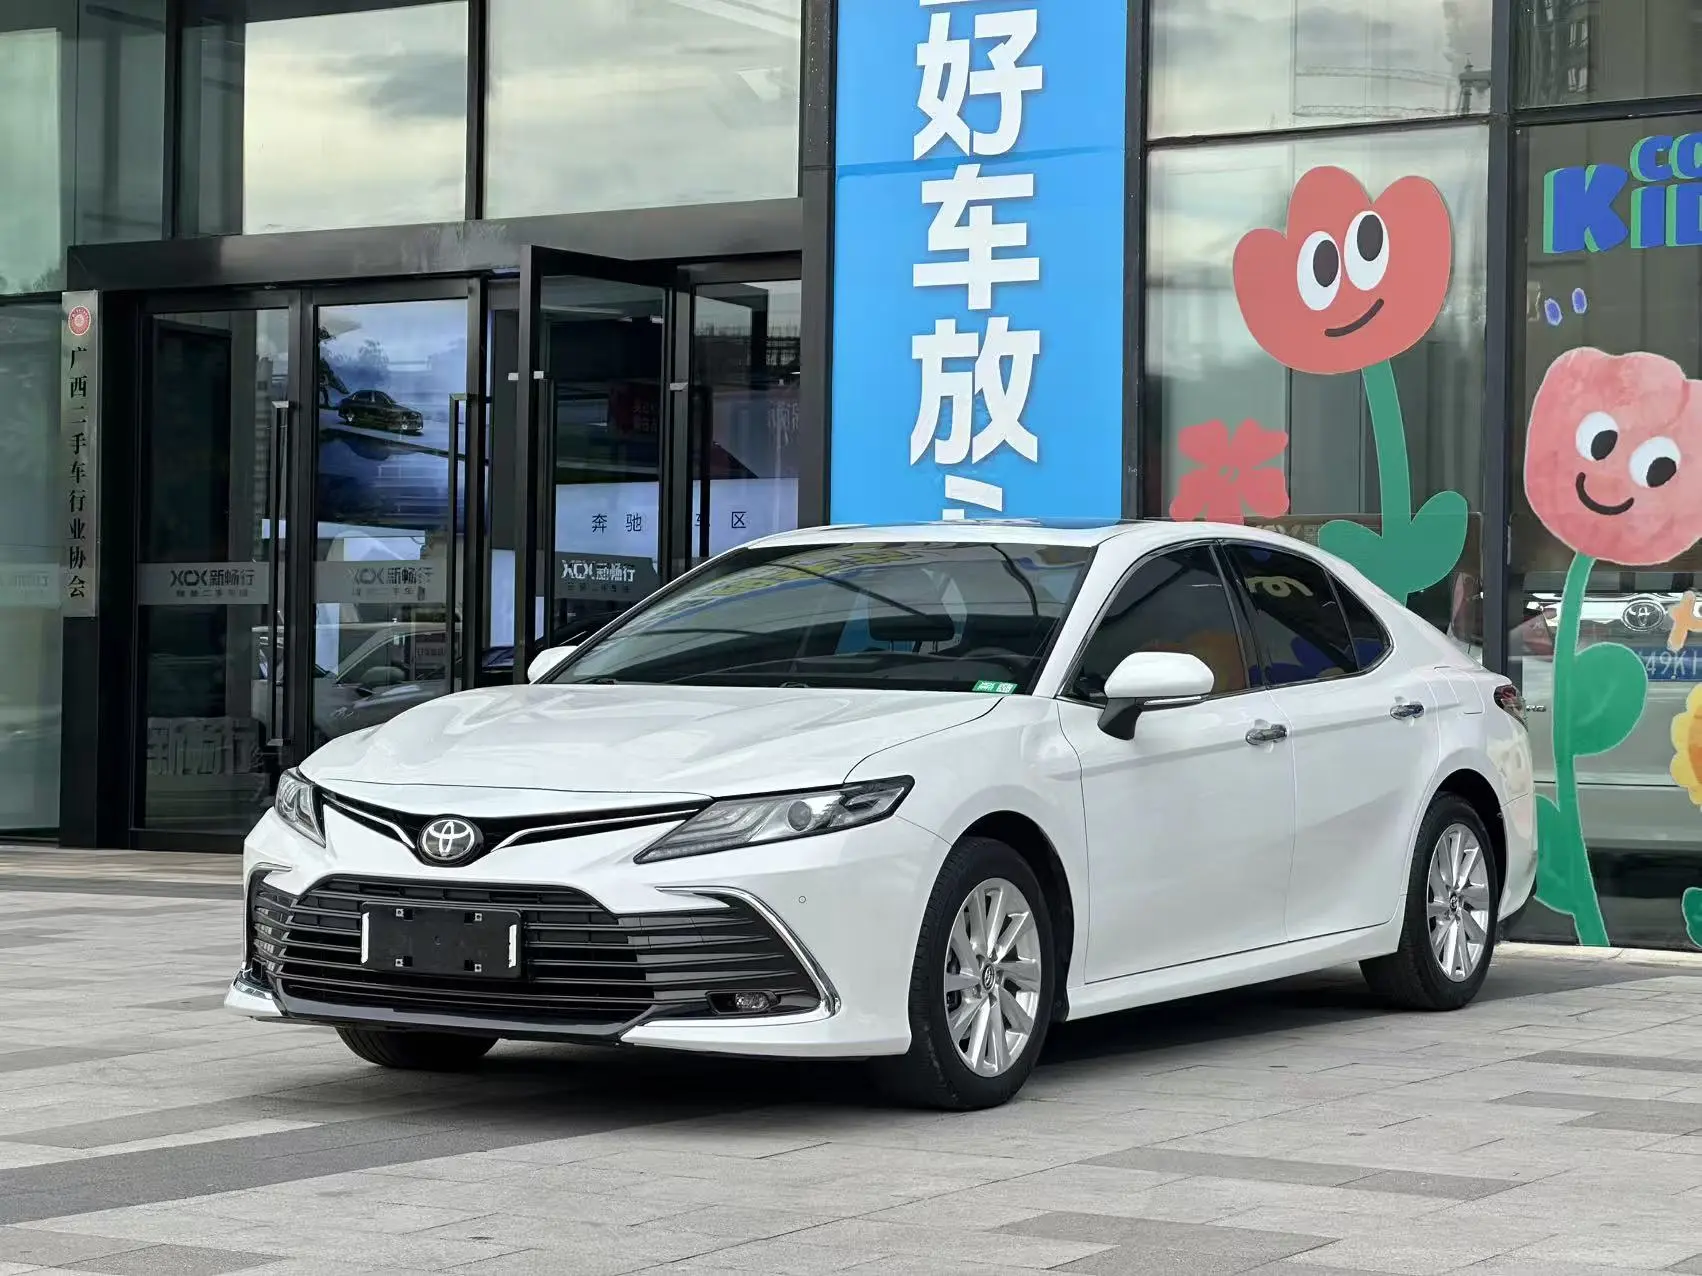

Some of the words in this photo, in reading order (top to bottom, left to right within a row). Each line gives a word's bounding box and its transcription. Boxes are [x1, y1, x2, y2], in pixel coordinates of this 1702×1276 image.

[911, 0, 1042, 520] 好车放
[68, 346, 87, 598] 广西二手车行业协会
